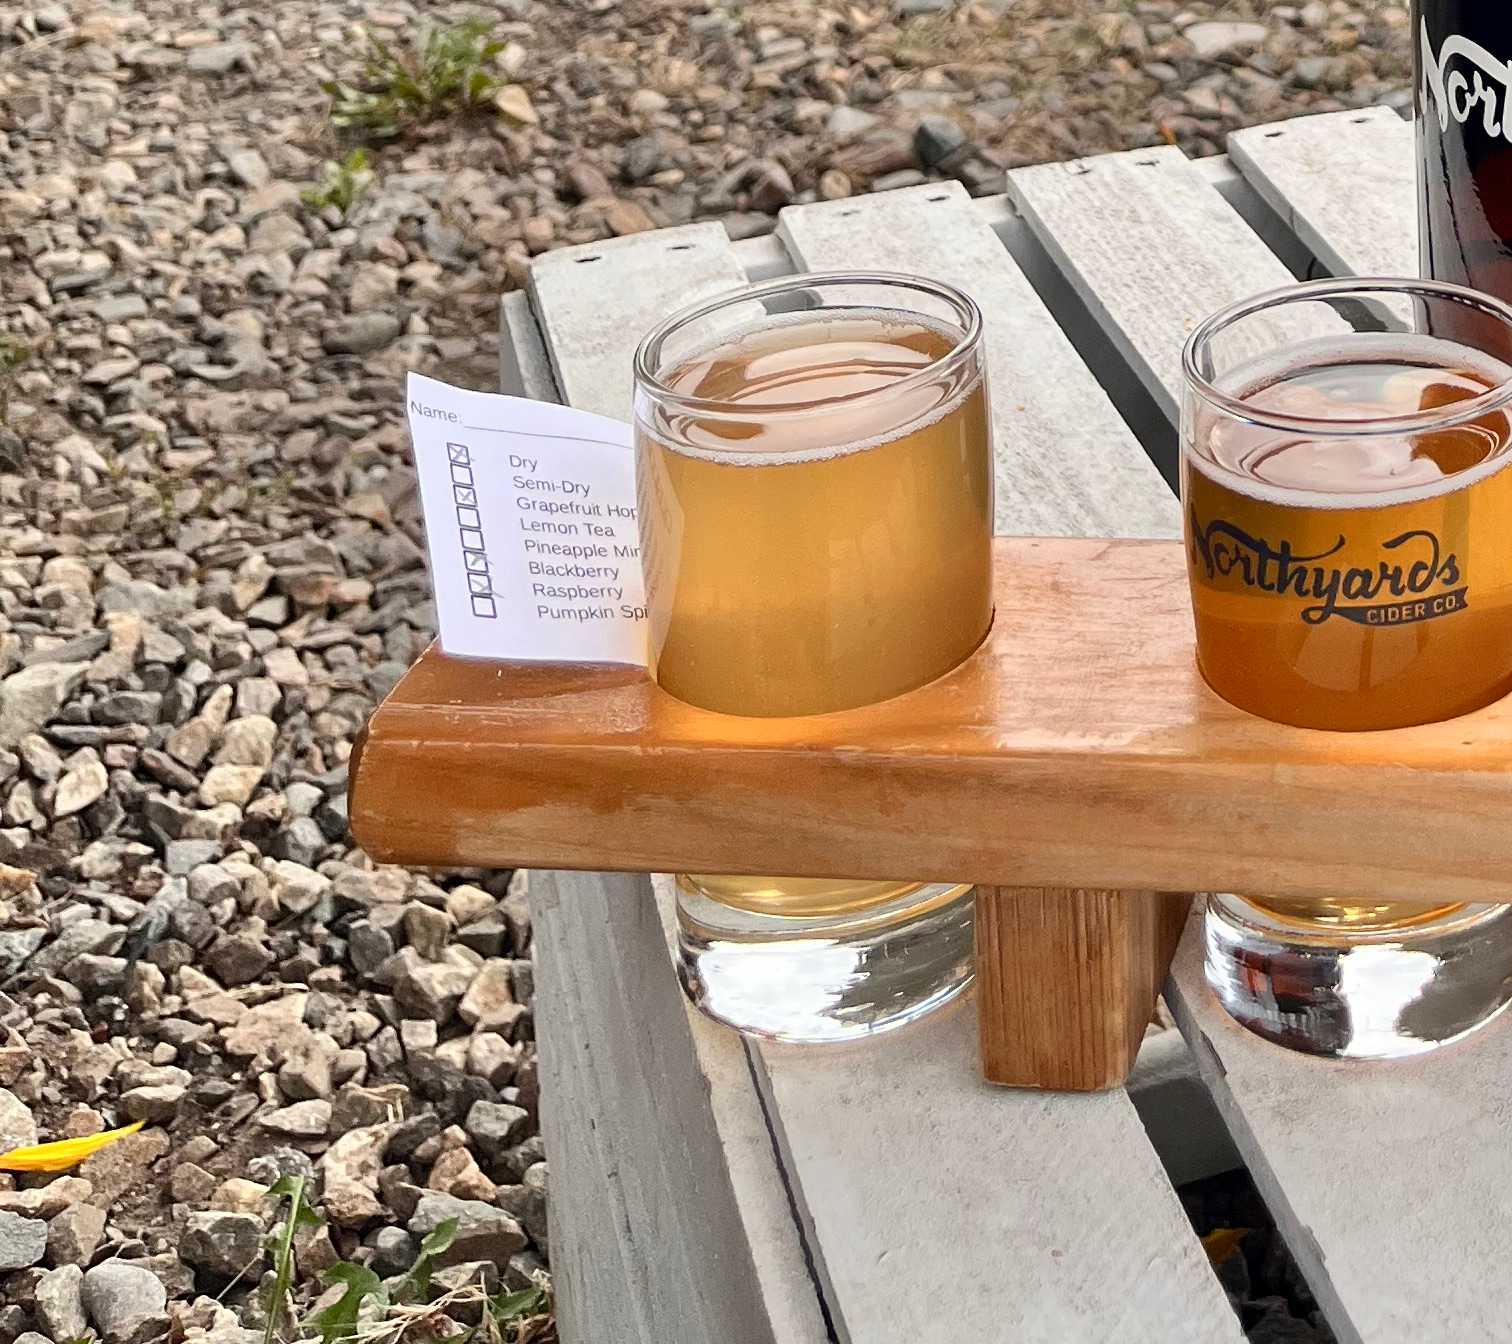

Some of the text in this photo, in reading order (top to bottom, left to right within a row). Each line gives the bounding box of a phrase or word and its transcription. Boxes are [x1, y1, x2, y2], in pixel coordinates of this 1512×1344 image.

[410, 400, 464, 424] Name:
[508, 454, 538, 472] Dry
[512, 475, 591, 497] Semi-Dry
[516, 496, 602, 516] Grapefruit
[519, 517, 616, 538] Lemon Tea
[523, 539, 609, 559] Pineapple
[528, 560, 620, 581] Blackberry
[1190, 502, 1461, 625] Northyards
[532, 582, 624, 602] Raspberry
[536, 604, 615, 624] Pumpkin
[1365, 594, 1461, 625] CIDER CO.
